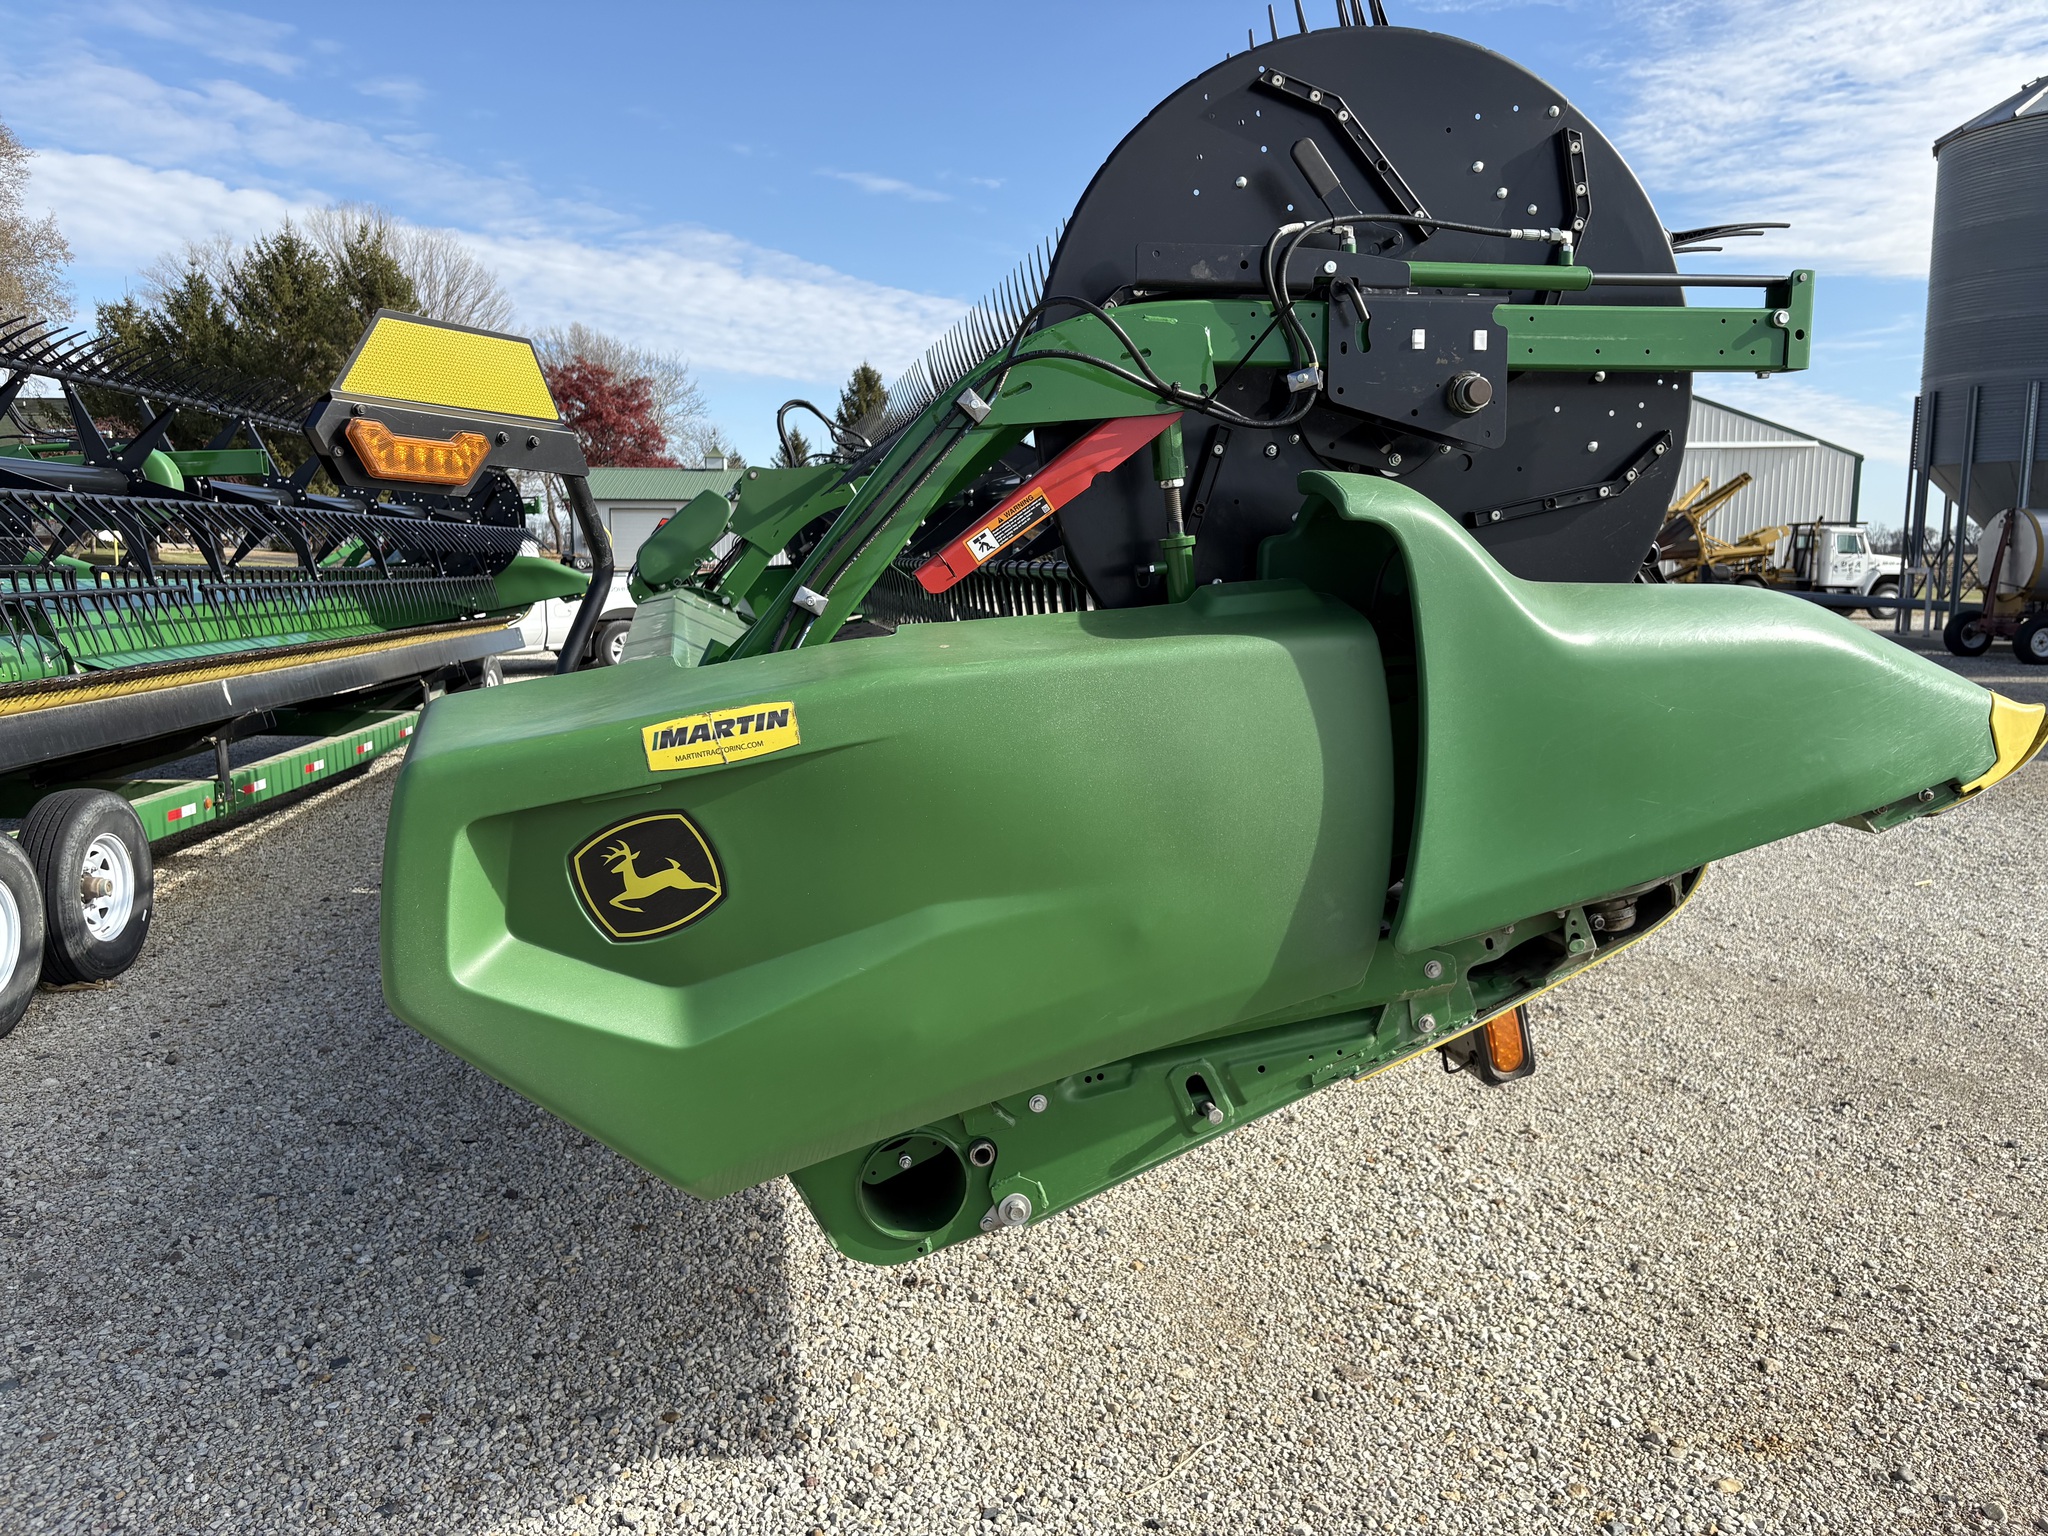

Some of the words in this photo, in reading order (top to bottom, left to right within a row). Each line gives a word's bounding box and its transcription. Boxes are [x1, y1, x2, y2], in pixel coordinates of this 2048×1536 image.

[1004, 495, 1034, 518] WARNING
[660, 709, 789, 749] MARTIN
[675, 741, 764, 762] MARTINTRACTORINC.COM
